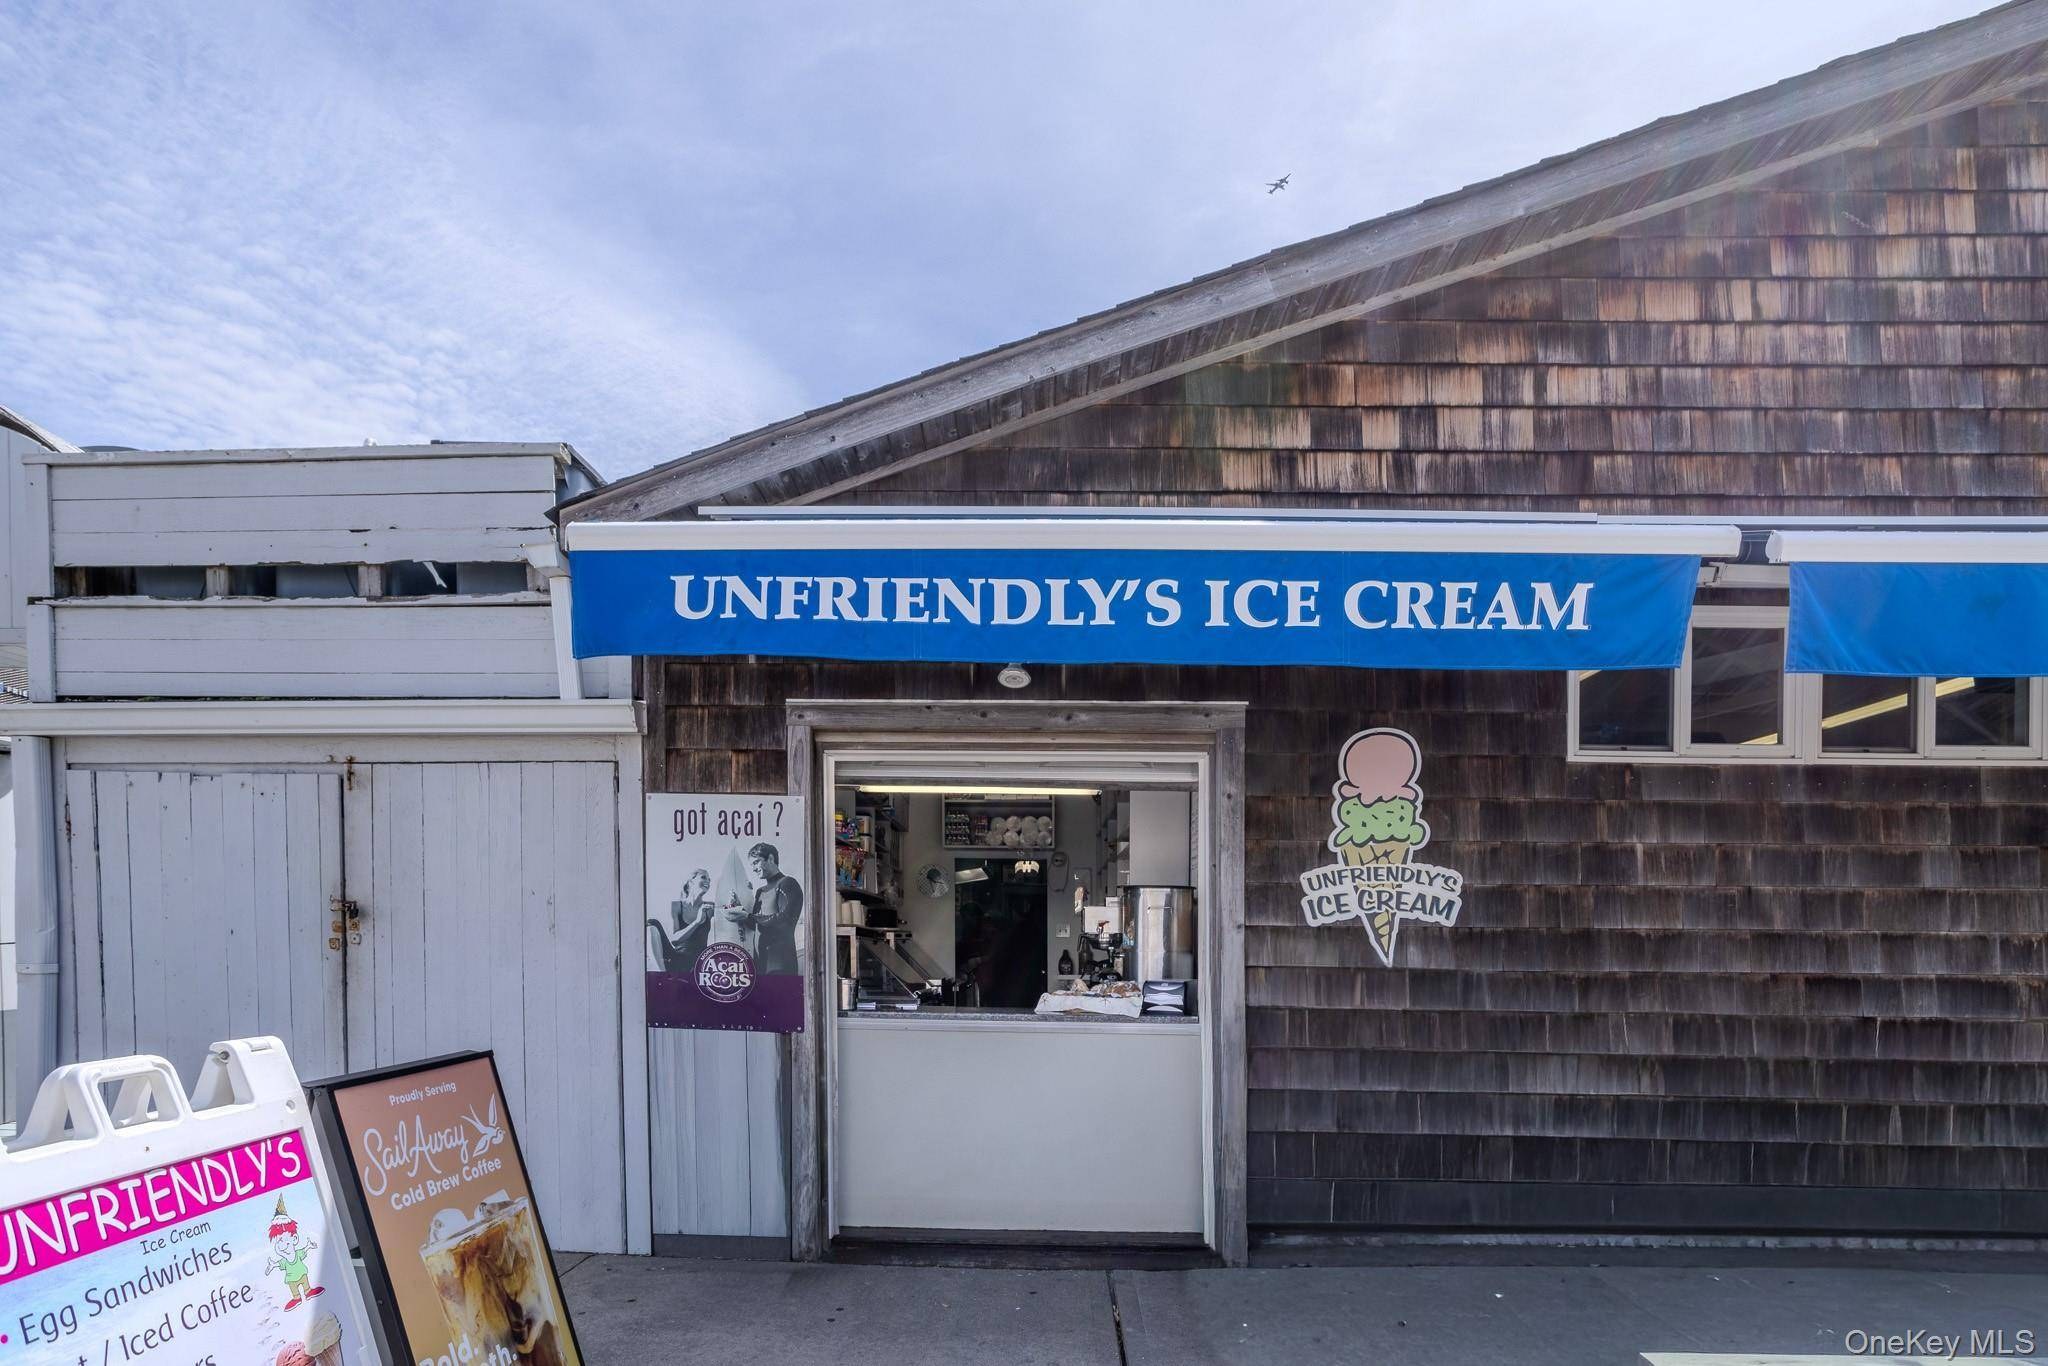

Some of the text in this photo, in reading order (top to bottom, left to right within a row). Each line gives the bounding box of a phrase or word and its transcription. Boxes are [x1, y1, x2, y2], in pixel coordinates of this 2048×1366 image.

[669, 574, 1594, 630] UNFRIENDLY'S ICE CREAM
[673, 801, 784, 842] got açaí ?
[1306, 865, 1459, 893] UNFRIENDLY'S
[1306, 888, 1457, 921] ICE CREAM
[389, 1081, 457, 1106] Proudly Serving
[390, 1156, 502, 1211] Cold Brew Coffee
[140, 1219, 212, 1256] Ice Cream
[19, 1240, 233, 1345] Egg Sandwiches
[119, 1312, 175, 1361] Iced
[180, 1283, 255, 1331] Coffee
